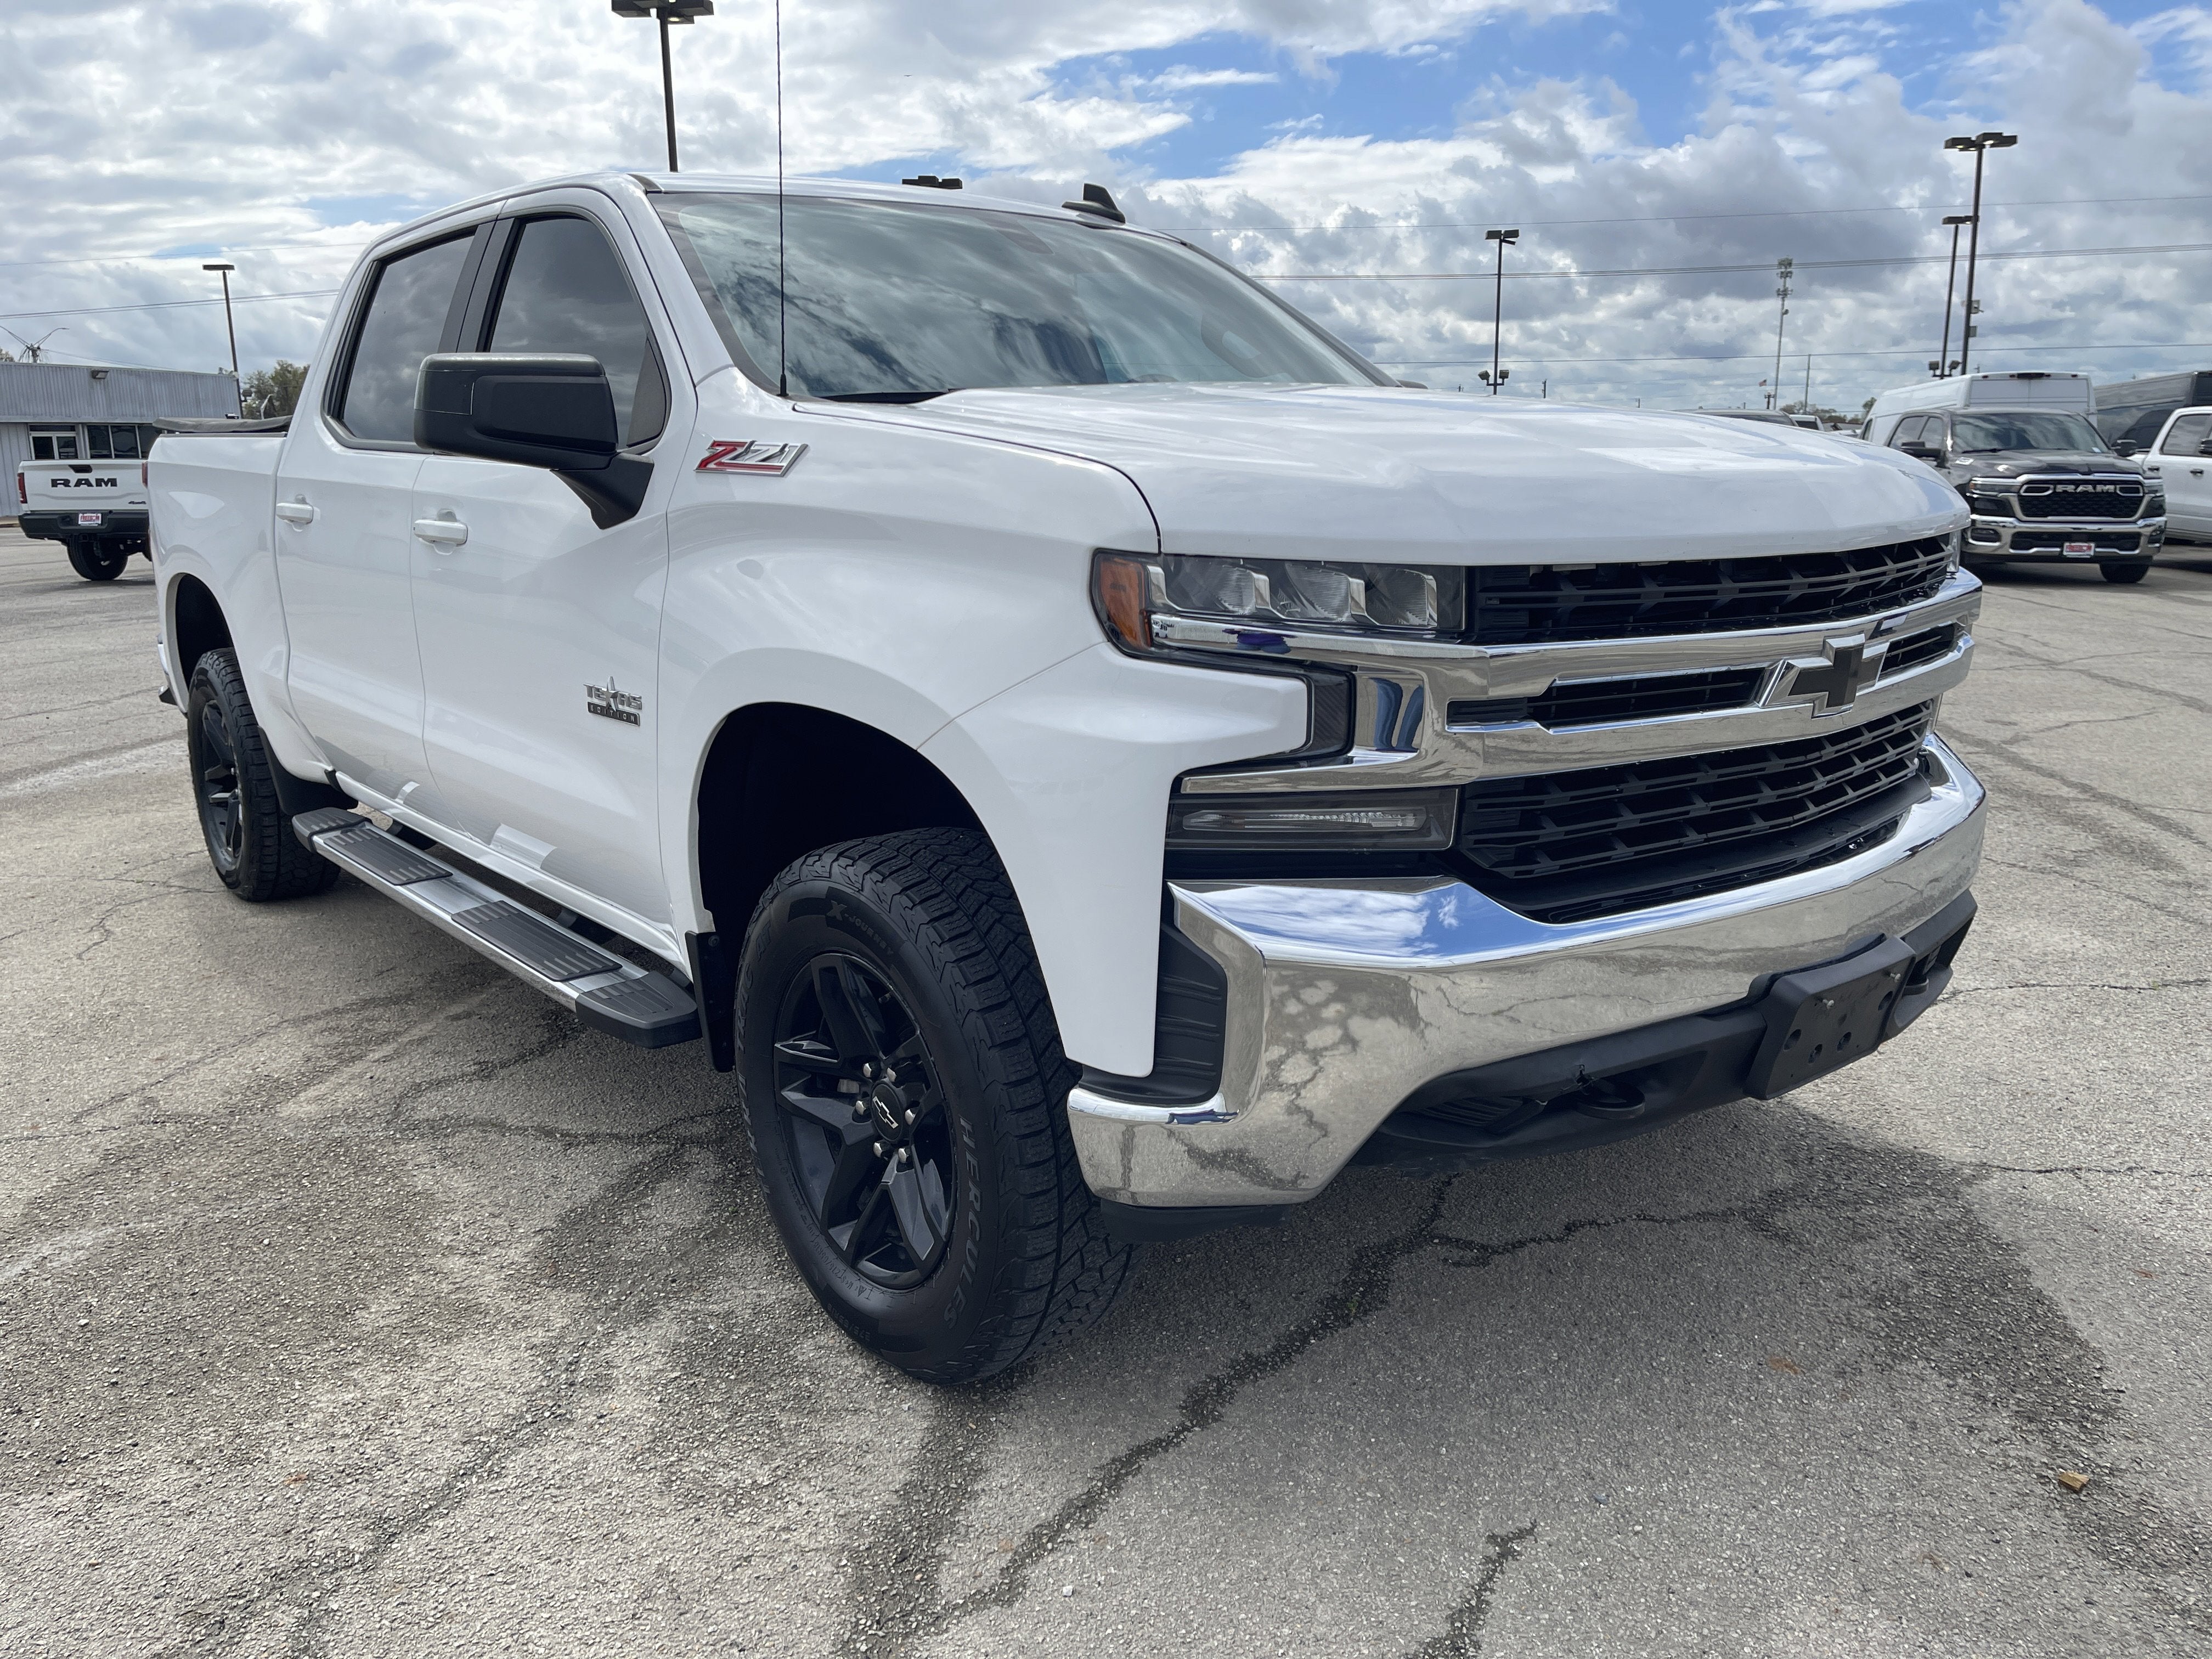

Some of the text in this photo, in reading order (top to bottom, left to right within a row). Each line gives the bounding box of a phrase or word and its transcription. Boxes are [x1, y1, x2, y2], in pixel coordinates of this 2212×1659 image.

[693, 439, 809, 477] Z71
[51, 478, 117, 488] RAM
[2055, 484, 2115, 493] RAM
[583, 682, 642, 710] TEAS
[590, 705, 635, 722] EDITION
[737, 963, 753, 1053] TRAC
[755, 919, 771, 961] AT
[944, 1114, 981, 1330] HERCULES
